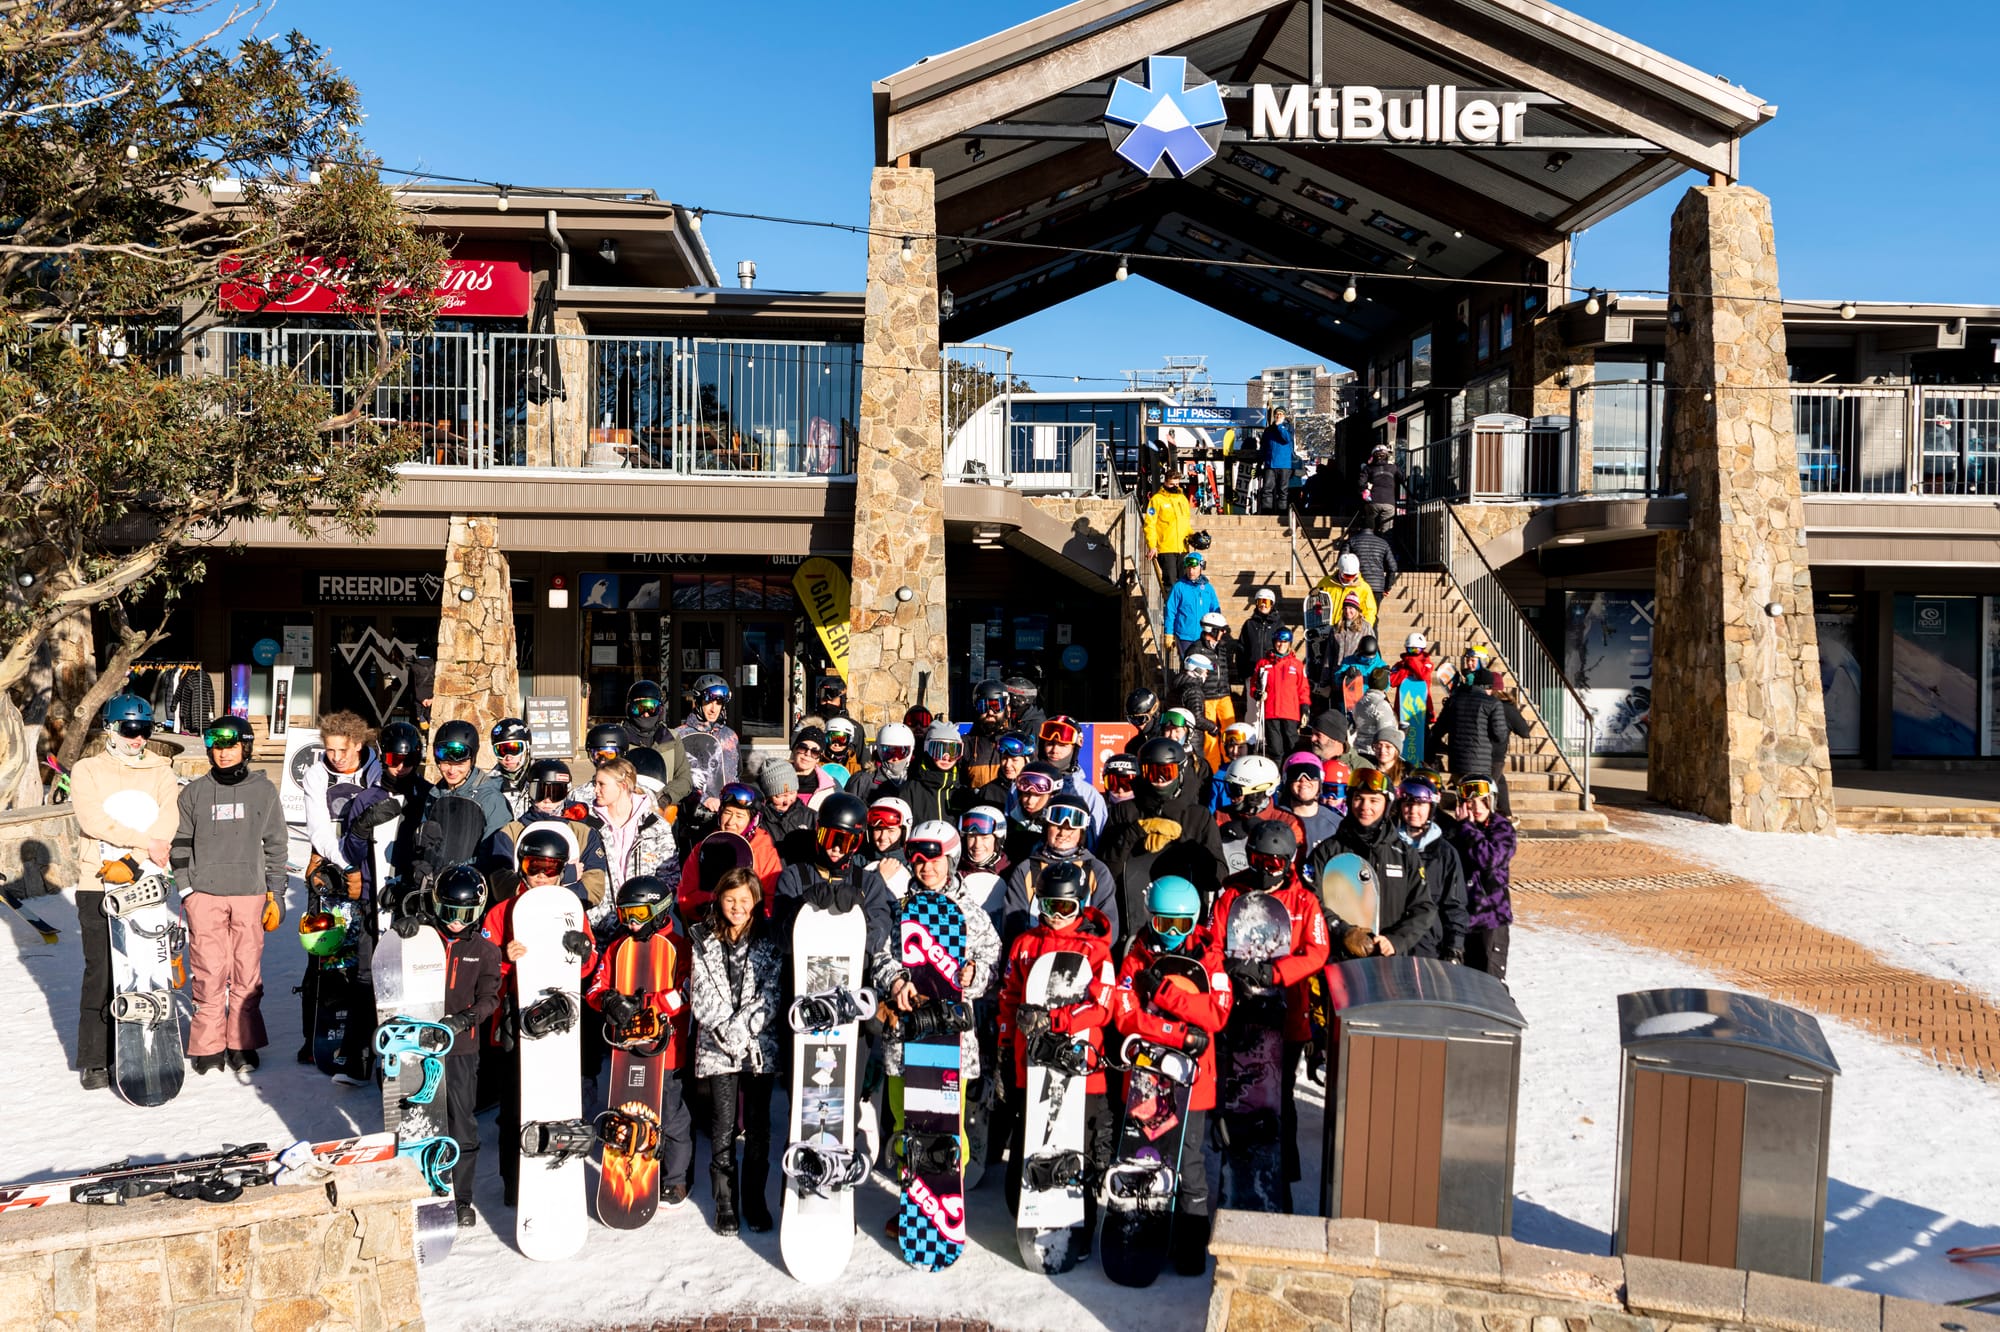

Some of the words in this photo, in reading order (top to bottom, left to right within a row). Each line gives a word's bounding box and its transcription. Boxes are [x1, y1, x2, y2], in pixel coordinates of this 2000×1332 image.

[1252, 83, 1527, 143] MtBuller
[1167, 408, 1189, 418] LIFT
[1191, 408, 1232, 419] PASSES
[319, 576, 417, 595] FREERIDE
